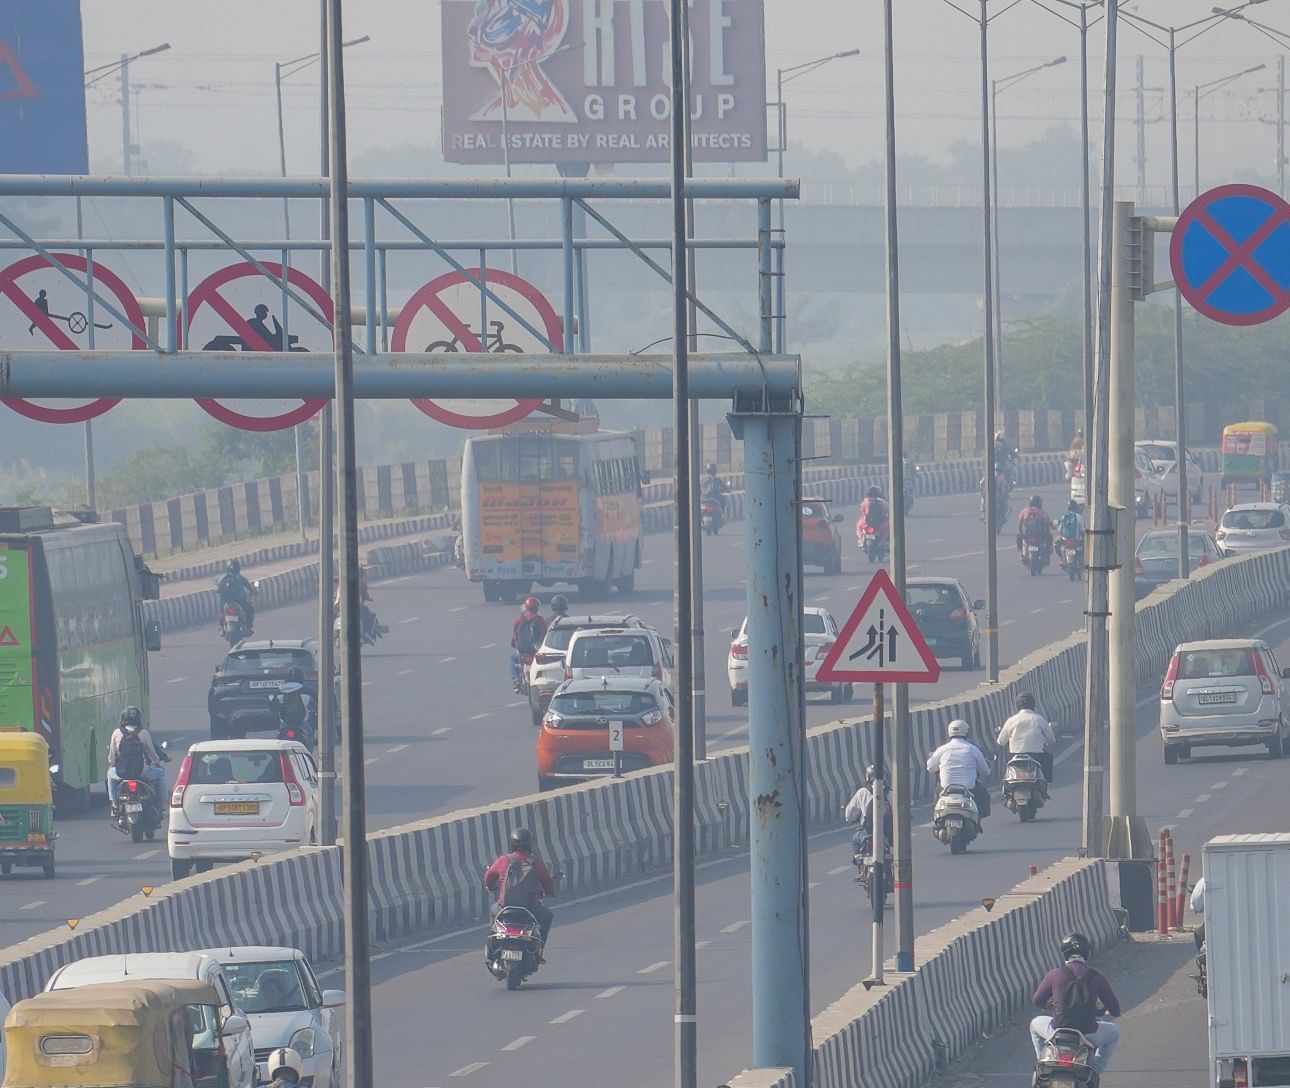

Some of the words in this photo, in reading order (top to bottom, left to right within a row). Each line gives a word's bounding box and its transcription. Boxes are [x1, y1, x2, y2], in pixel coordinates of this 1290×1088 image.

[453, 134, 496, 149] REAL
[503, 134, 562, 149] ESTATE
[567, 134, 590, 149] BY
[596, 134, 640, 149] REAL
[646, 133, 751, 149] ARITECTS
[613, 730, 620, 742] 2
